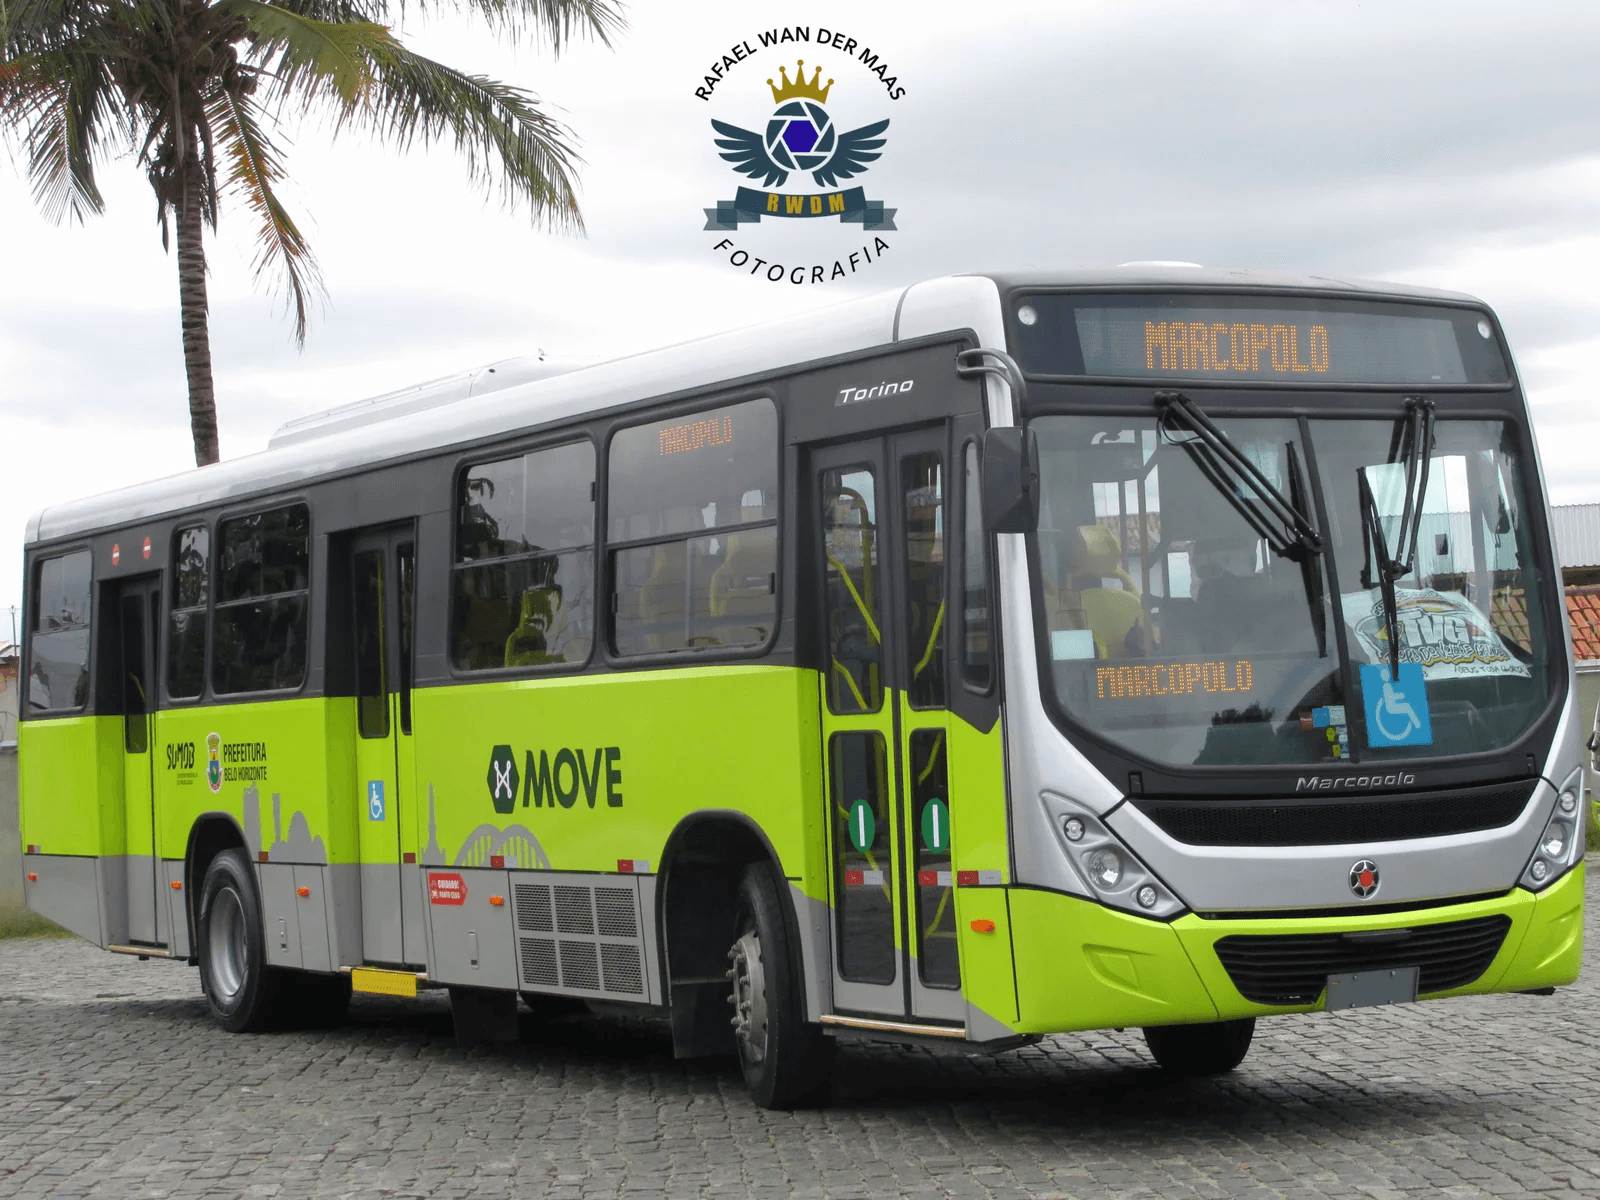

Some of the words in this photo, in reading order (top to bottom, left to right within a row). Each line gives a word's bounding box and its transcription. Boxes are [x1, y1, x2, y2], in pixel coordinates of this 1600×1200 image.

[1145, 321, 1329, 372] MARCOPOLO
[840, 380, 913, 403] Torino
[1397, 608, 1470, 647] TVG
[1097, 660, 1252, 698] MARCOPOLO
[223, 742, 267, 763] PREFEITURA
[224, 767, 238, 782] BELO
[238, 766, 267, 781] HORIZONTE
[522, 746, 624, 809] MOVE
[1295, 771, 1416, 792] Marcopolo
